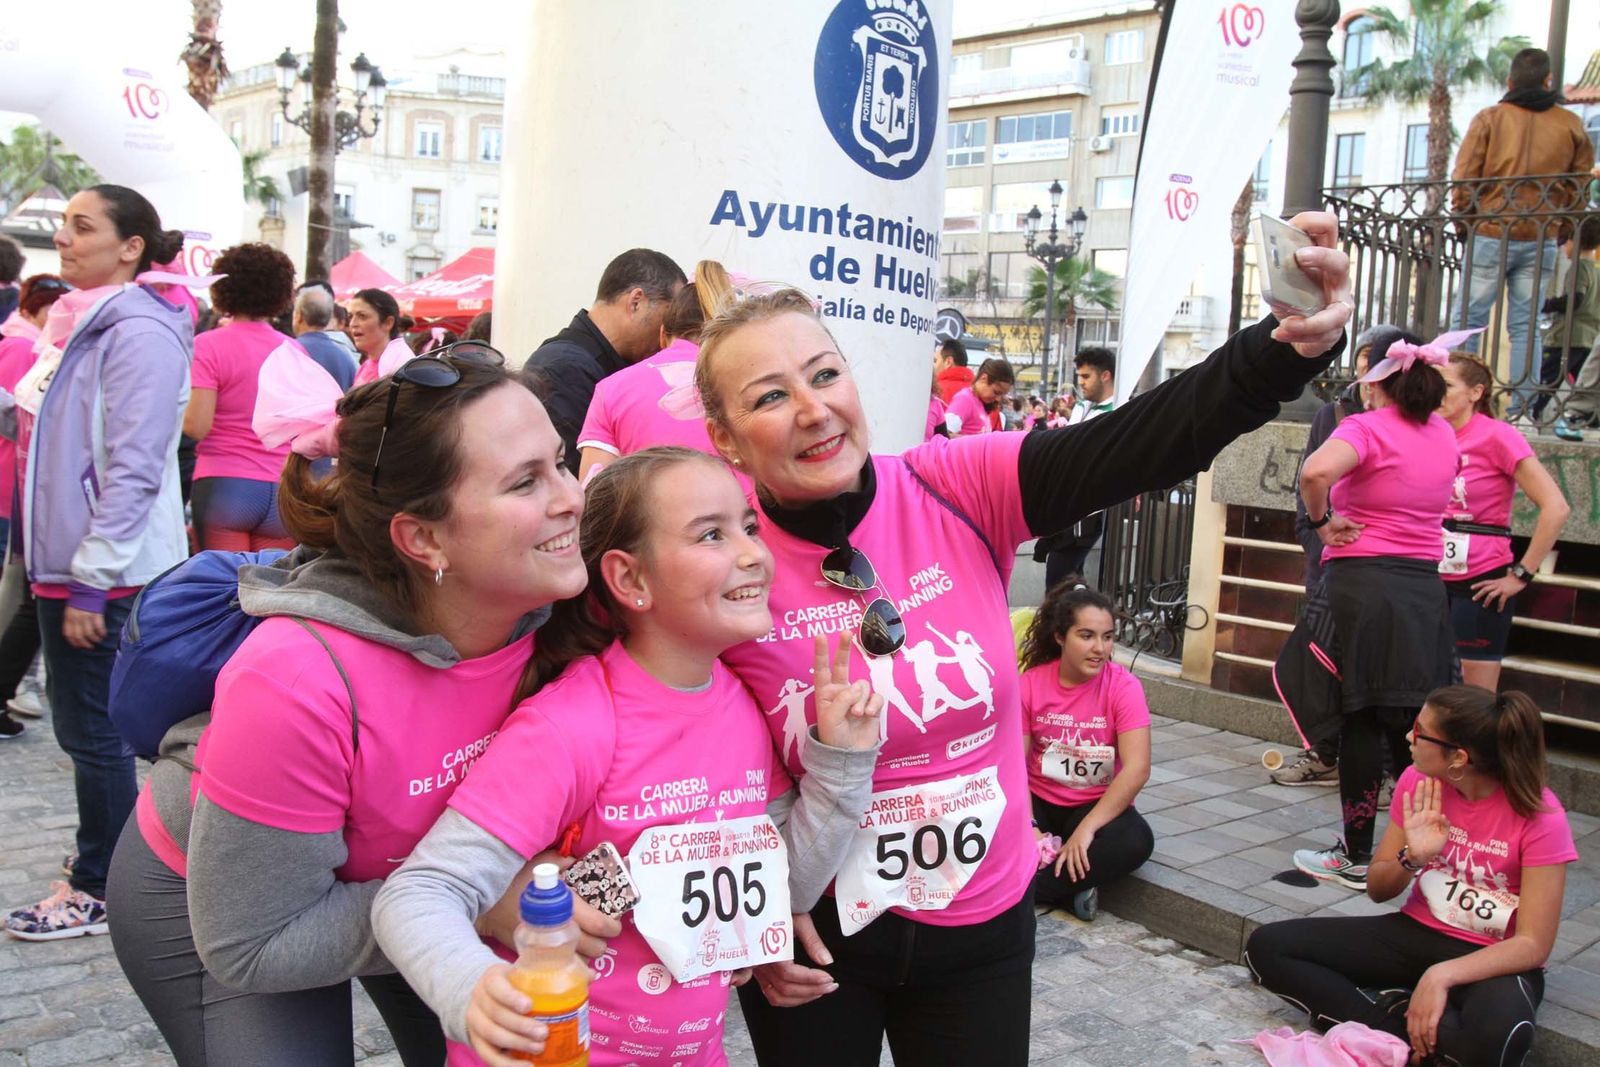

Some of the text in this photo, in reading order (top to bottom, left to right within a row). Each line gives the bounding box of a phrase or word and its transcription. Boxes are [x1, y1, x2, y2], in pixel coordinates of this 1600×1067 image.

[880, 44, 909, 61] ET TERRA
[862, 54, 874, 122] PORTUS MARIS
[1216, 71, 1260, 87] musical
[709, 189, 941, 263] Ayuntamient
[809, 246, 861, 285] de
[873, 303, 895, 325] de
[909, 562, 946, 591] PINK
[781, 625, 803, 641] LA
[807, 613, 863, 638] MUJER
[897, 575, 954, 616] UNNING
[784, 598, 861, 627] CARRERA
[1044, 717, 1052, 725] LA
[1052, 719, 1074, 728] MUJER
[1079, 721, 1108, 729] RUNNING
[1047, 712, 1074, 722] CARRERA
[950, 729, 994, 753] ekiden
[890, 757, 931, 769] de Huelva
[1060, 757, 1104, 777] 167
[409, 768, 456, 796] DE LA
[640, 776, 709, 803] CARRERA
[864, 793, 924, 815] ARRERA
[965, 776, 991, 795] PINK
[604, 785, 767, 821] DE LA MUJER & RUNNING
[879, 807, 926, 827] MUJER
[930, 809, 938, 818] &
[941, 788, 996, 816] RUNNING
[641, 836, 779, 865] DE LA MUJER & RUNNING
[669, 830, 721, 847] CARRERA
[876, 816, 987, 881] 506
[1448, 832, 1468, 845] UJER
[1473, 841, 1509, 858] RUNNING
[1449, 825, 1508, 849] RERA PINK
[682, 861, 766, 928] 505
[1444, 880, 1497, 920] 168
[719, 948, 749, 960] HUELVA
[678, 1017, 711, 1034] Coca-Cola
[619, 1046, 660, 1058] SHOPPING
